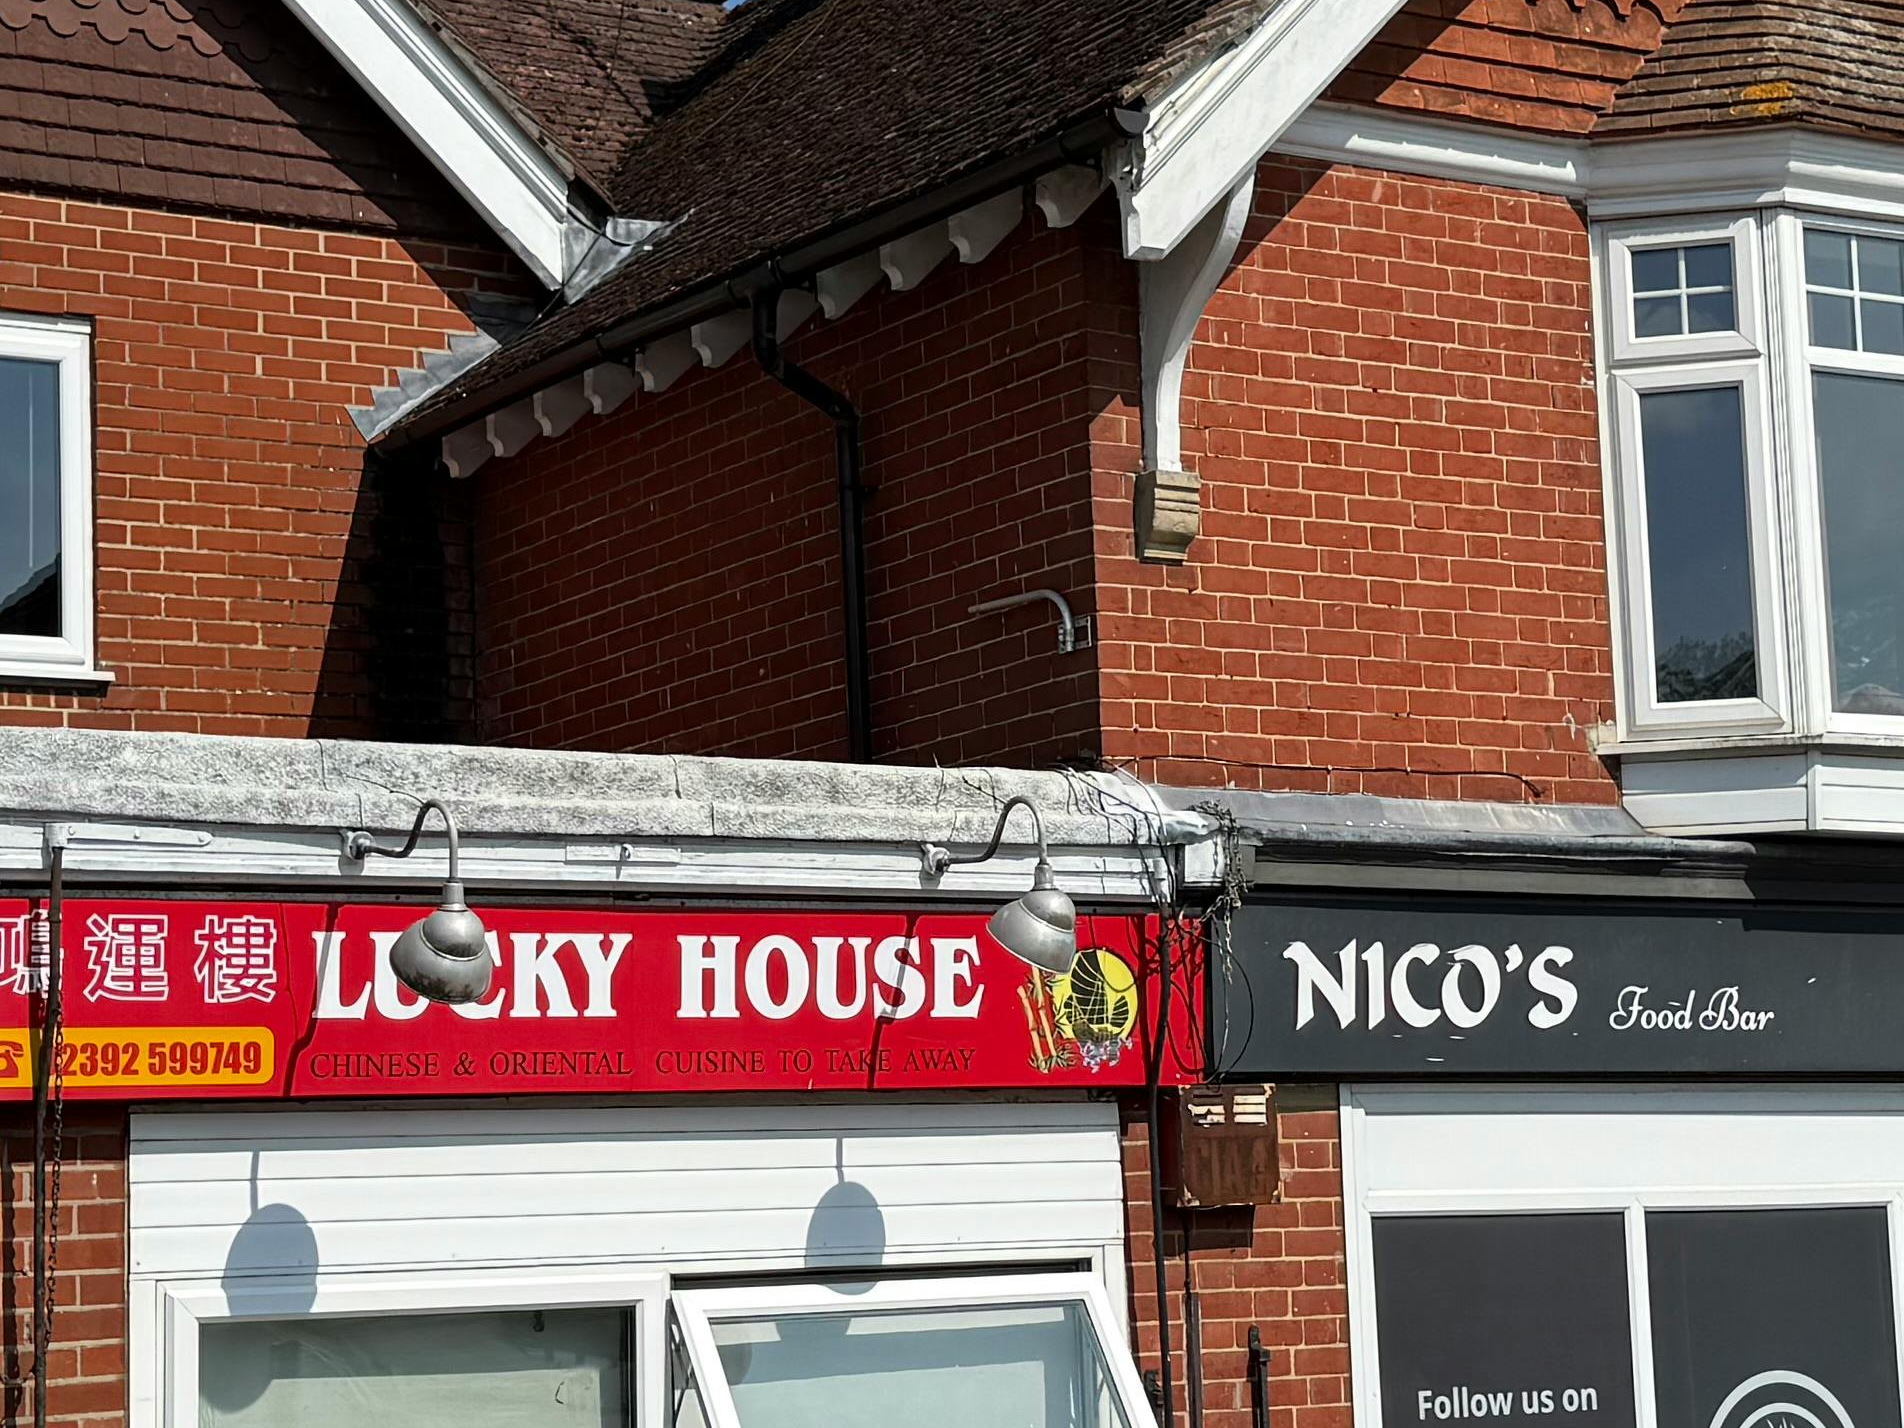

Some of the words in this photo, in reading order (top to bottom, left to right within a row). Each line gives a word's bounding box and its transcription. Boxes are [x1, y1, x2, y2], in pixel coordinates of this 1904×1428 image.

[676, 934, 985, 1020] HOUSE
[1282, 939, 1578, 1031] NICO'S
[1609, 985, 1695, 1032] Food
[1698, 985, 1775, 1032] Bar
[60, 1042, 139, 1076] 2392
[148, 1041, 261, 1076] 599749
[310, 1052, 440, 1078] CHINESE
[453, 1052, 476, 1076] &
[489, 1052, 633, 1076] ORIENTAL
[655, 1050, 766, 1073] CUISINE
[777, 1049, 812, 1073] TO
[824, 1049, 892, 1072] TAKE
[903, 1048, 976, 1072] AWAY
[1417, 1386, 1513, 1421] Follow
[1521, 1389, 1555, 1414] us
[1562, 1387, 1598, 1412] on
